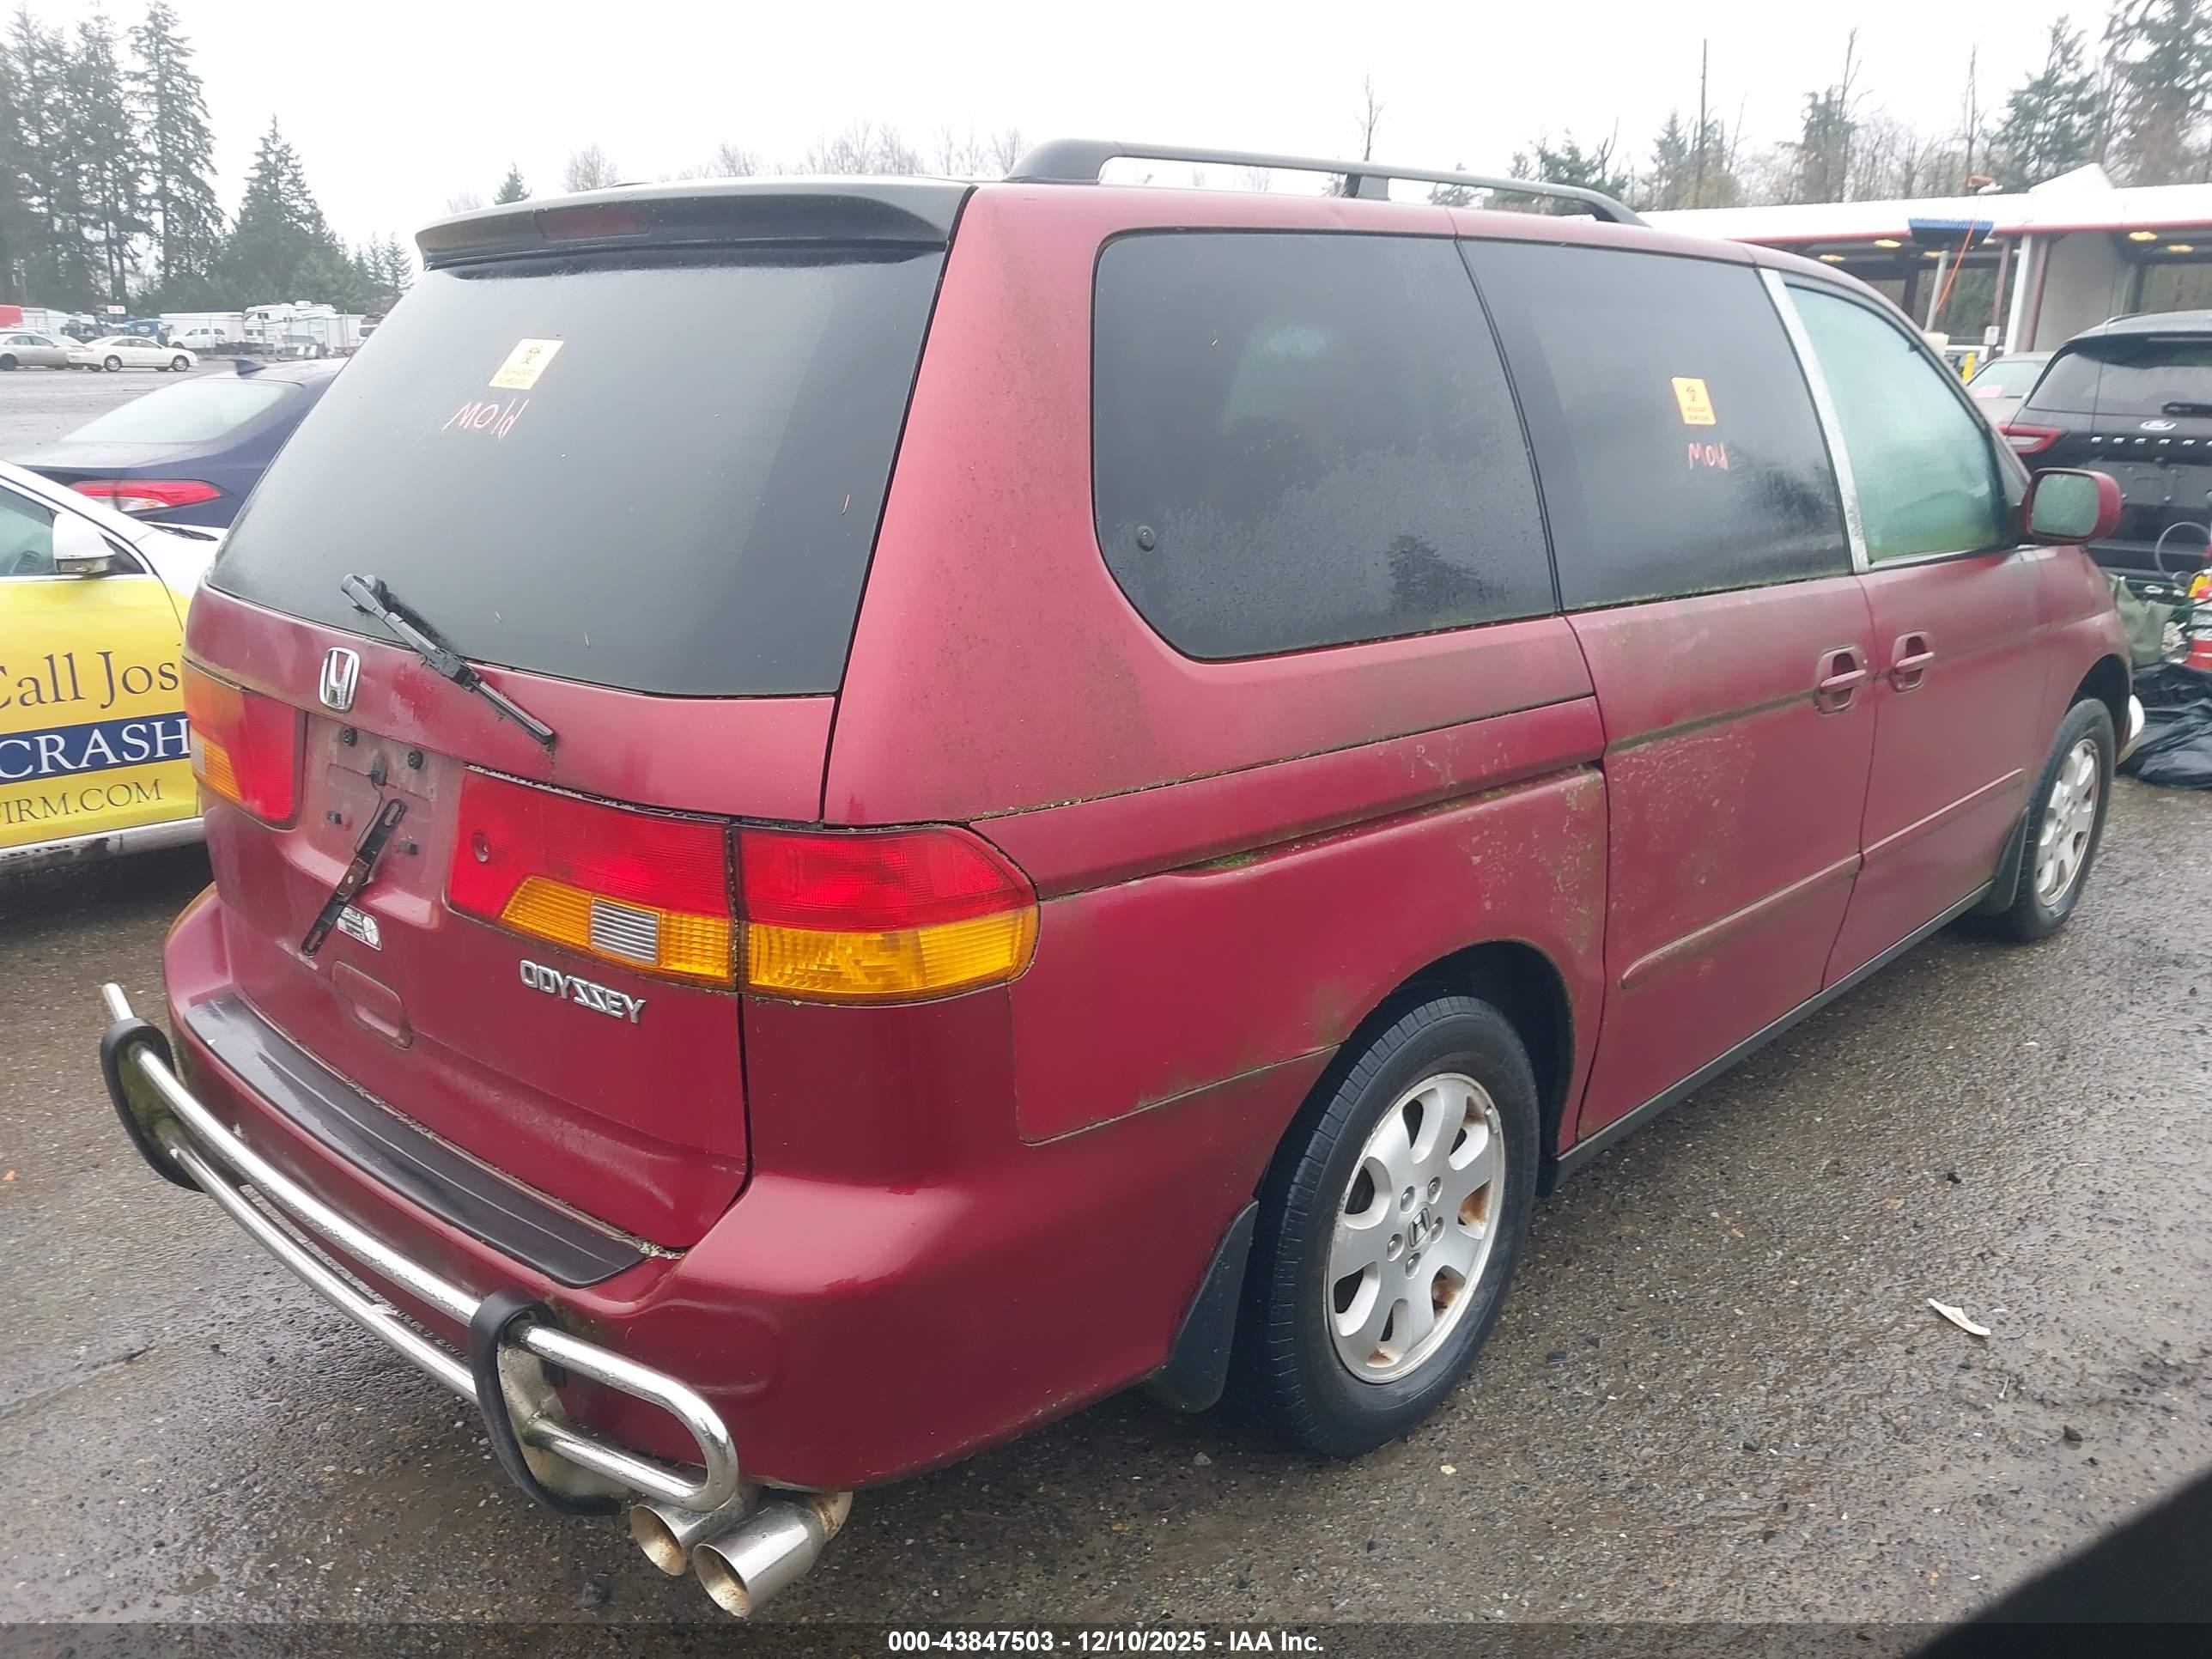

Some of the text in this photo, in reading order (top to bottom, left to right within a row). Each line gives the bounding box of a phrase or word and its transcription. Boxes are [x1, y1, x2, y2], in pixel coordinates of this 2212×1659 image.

[0, 718, 191, 779] CRASH
[0, 778, 164, 824] IRM.COM
[520, 959, 647, 1024] ODYSSEY
